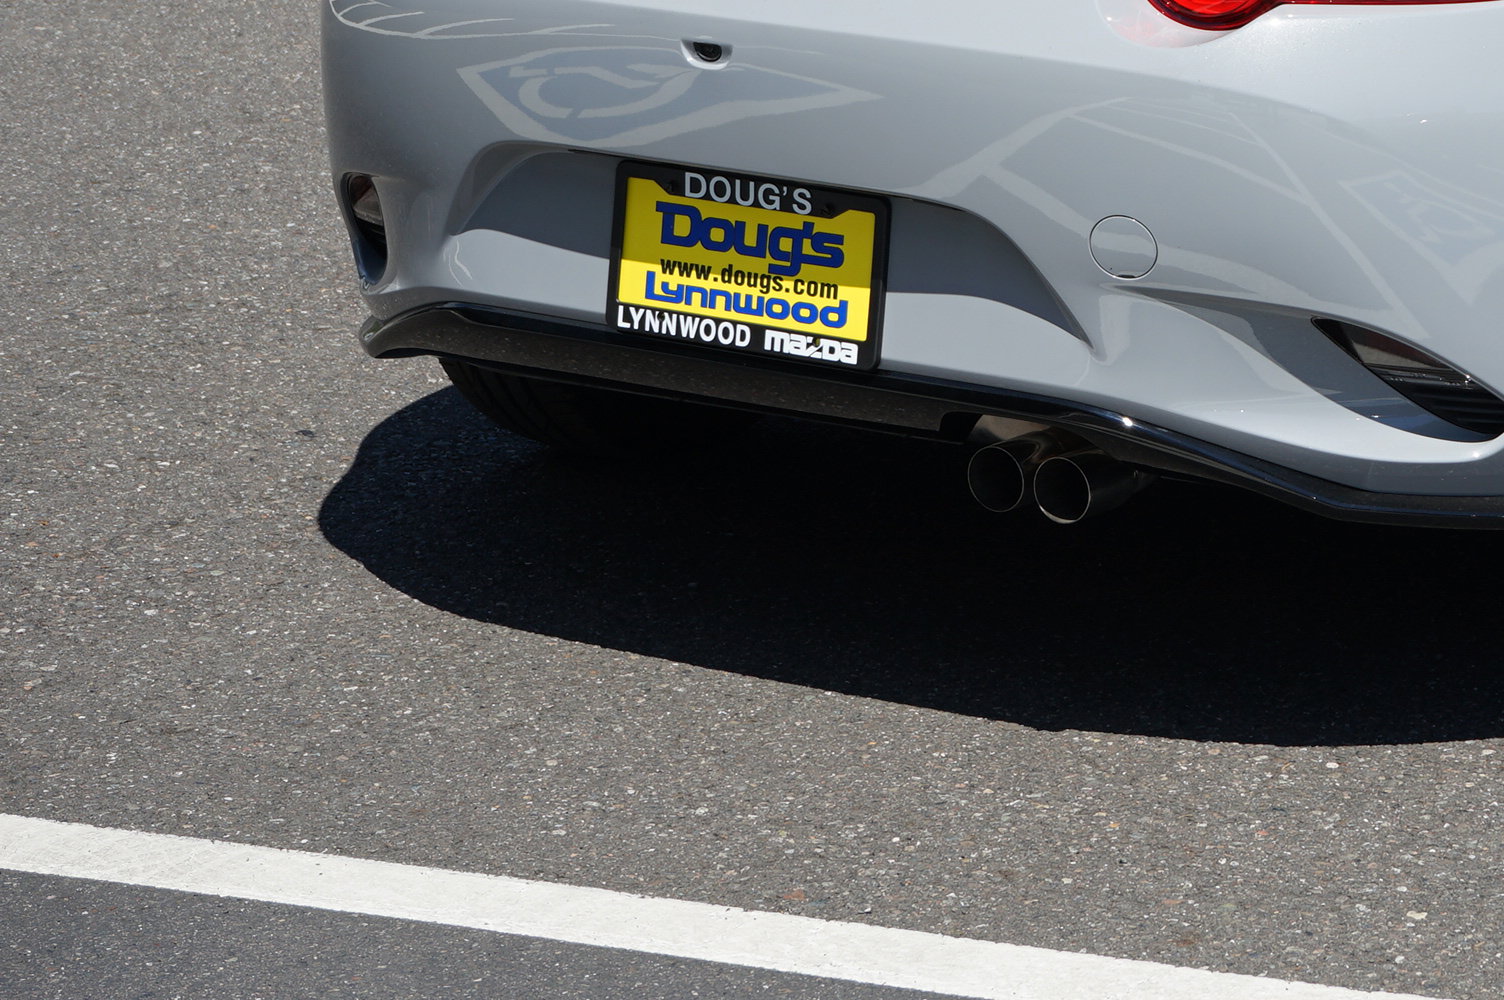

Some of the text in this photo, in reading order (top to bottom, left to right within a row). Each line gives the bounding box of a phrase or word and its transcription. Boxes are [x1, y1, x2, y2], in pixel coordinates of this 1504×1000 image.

[684, 171, 813, 216] DOUG'S
[655, 200, 845, 277] Doug's
[644, 269, 849, 330] Lynnwood
[659, 257, 839, 301] www.dougs.com
[617, 304, 751, 348] LYNNWOOD
